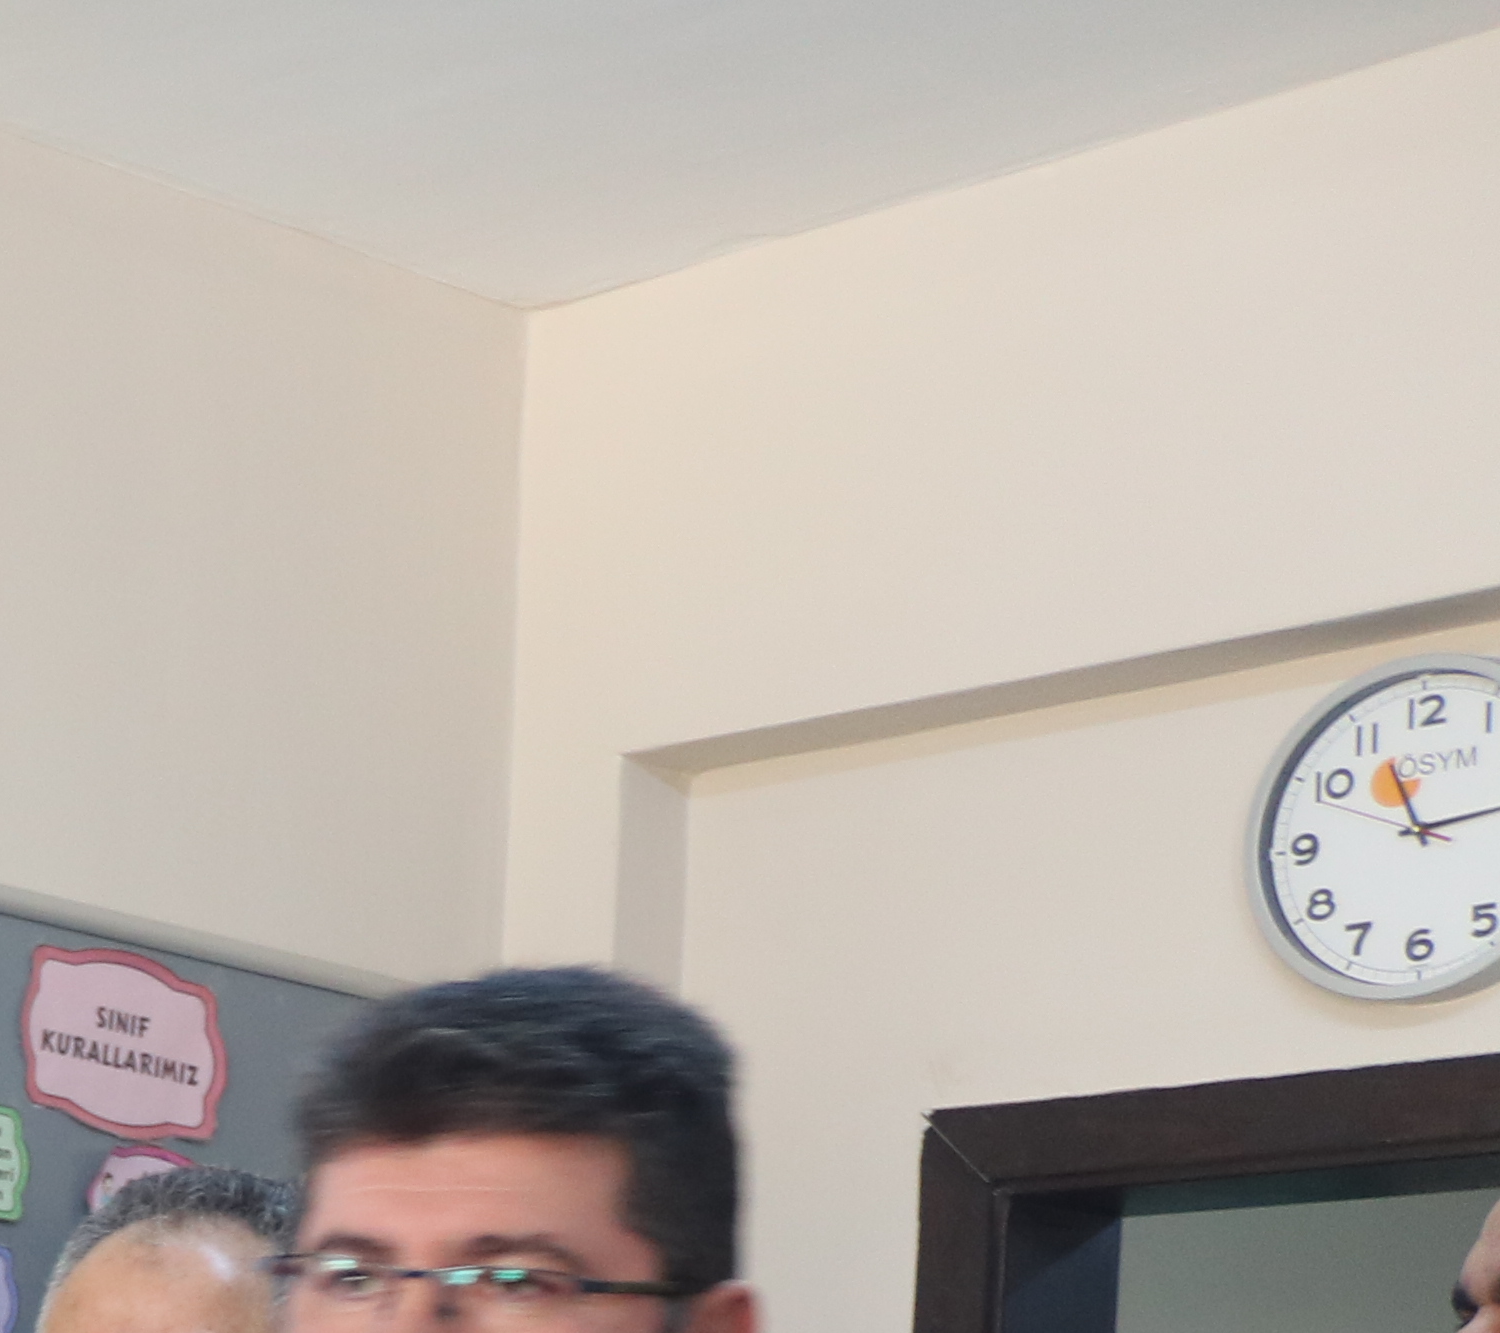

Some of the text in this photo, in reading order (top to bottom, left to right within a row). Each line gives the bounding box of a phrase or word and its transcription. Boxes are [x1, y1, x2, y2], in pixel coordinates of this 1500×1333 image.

[1408, 694, 1448, 730] 12
[1356, 722, 1380, 757] 11
[1399, 746, 1479, 780] ÖSYM
[1314, 767, 1355, 802] 10
[1291, 832, 1321, 866] 9
[1306, 888, 1336, 921] 8
[1470, 902, 1499, 938] 5
[1345, 921, 1374, 956] 7
[1405, 928, 1435, 962] 6
[96, 1005, 151, 1038] SINIF
[41, 1028, 199, 1089] KURALLARIMIZ
